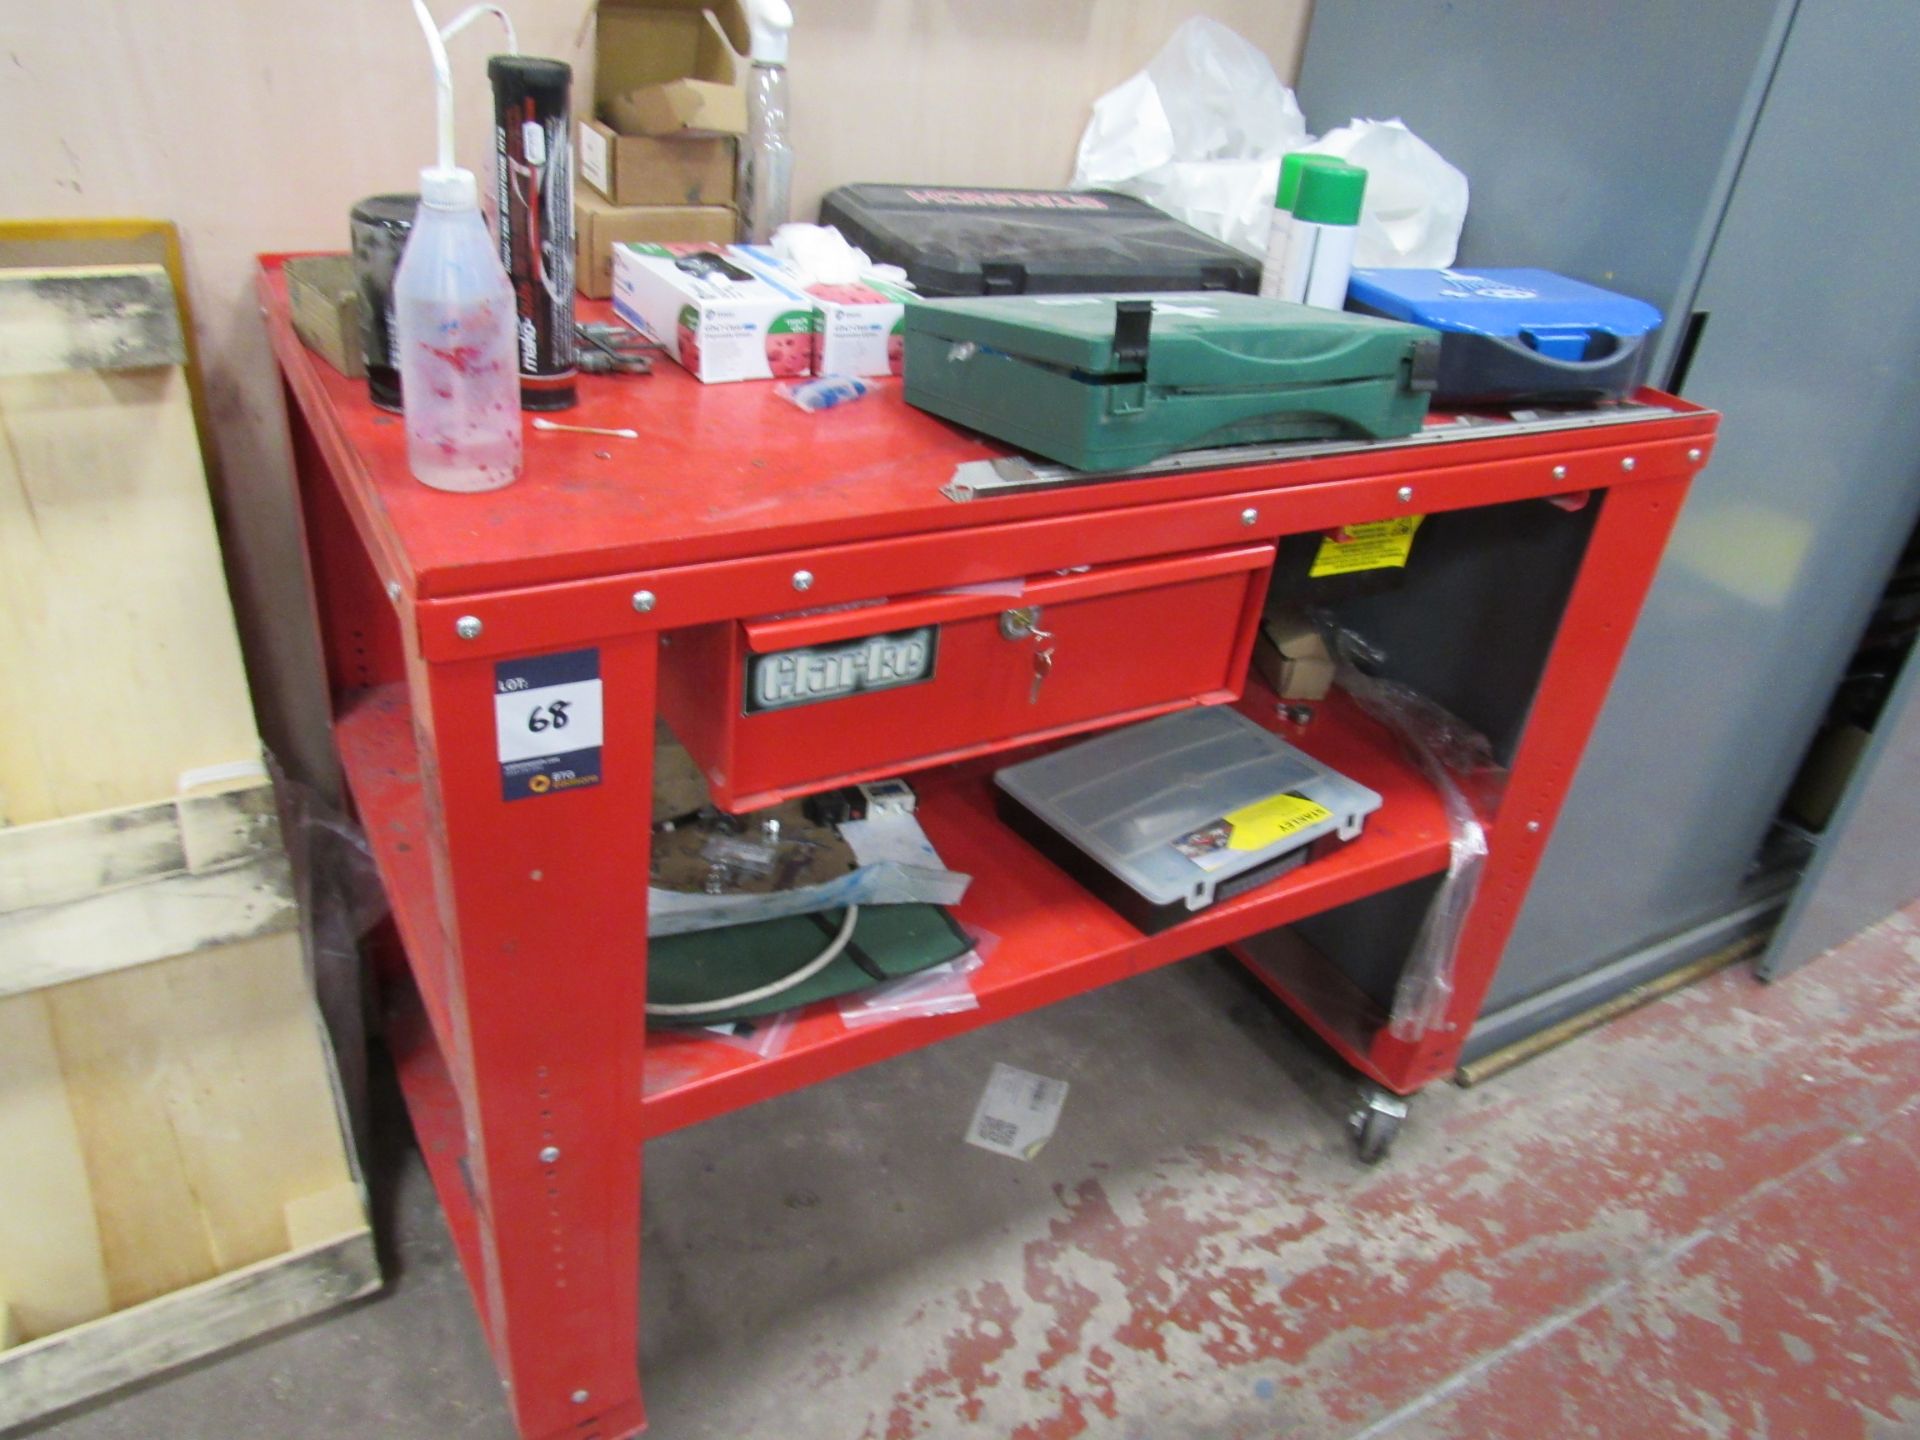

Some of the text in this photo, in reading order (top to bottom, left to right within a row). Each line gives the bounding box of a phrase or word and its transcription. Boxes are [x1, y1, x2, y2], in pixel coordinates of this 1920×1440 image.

[761, 637, 925, 703] Clarke
[528, 699, 572, 733] 68
[1279, 807, 1327, 833] STANLEY
